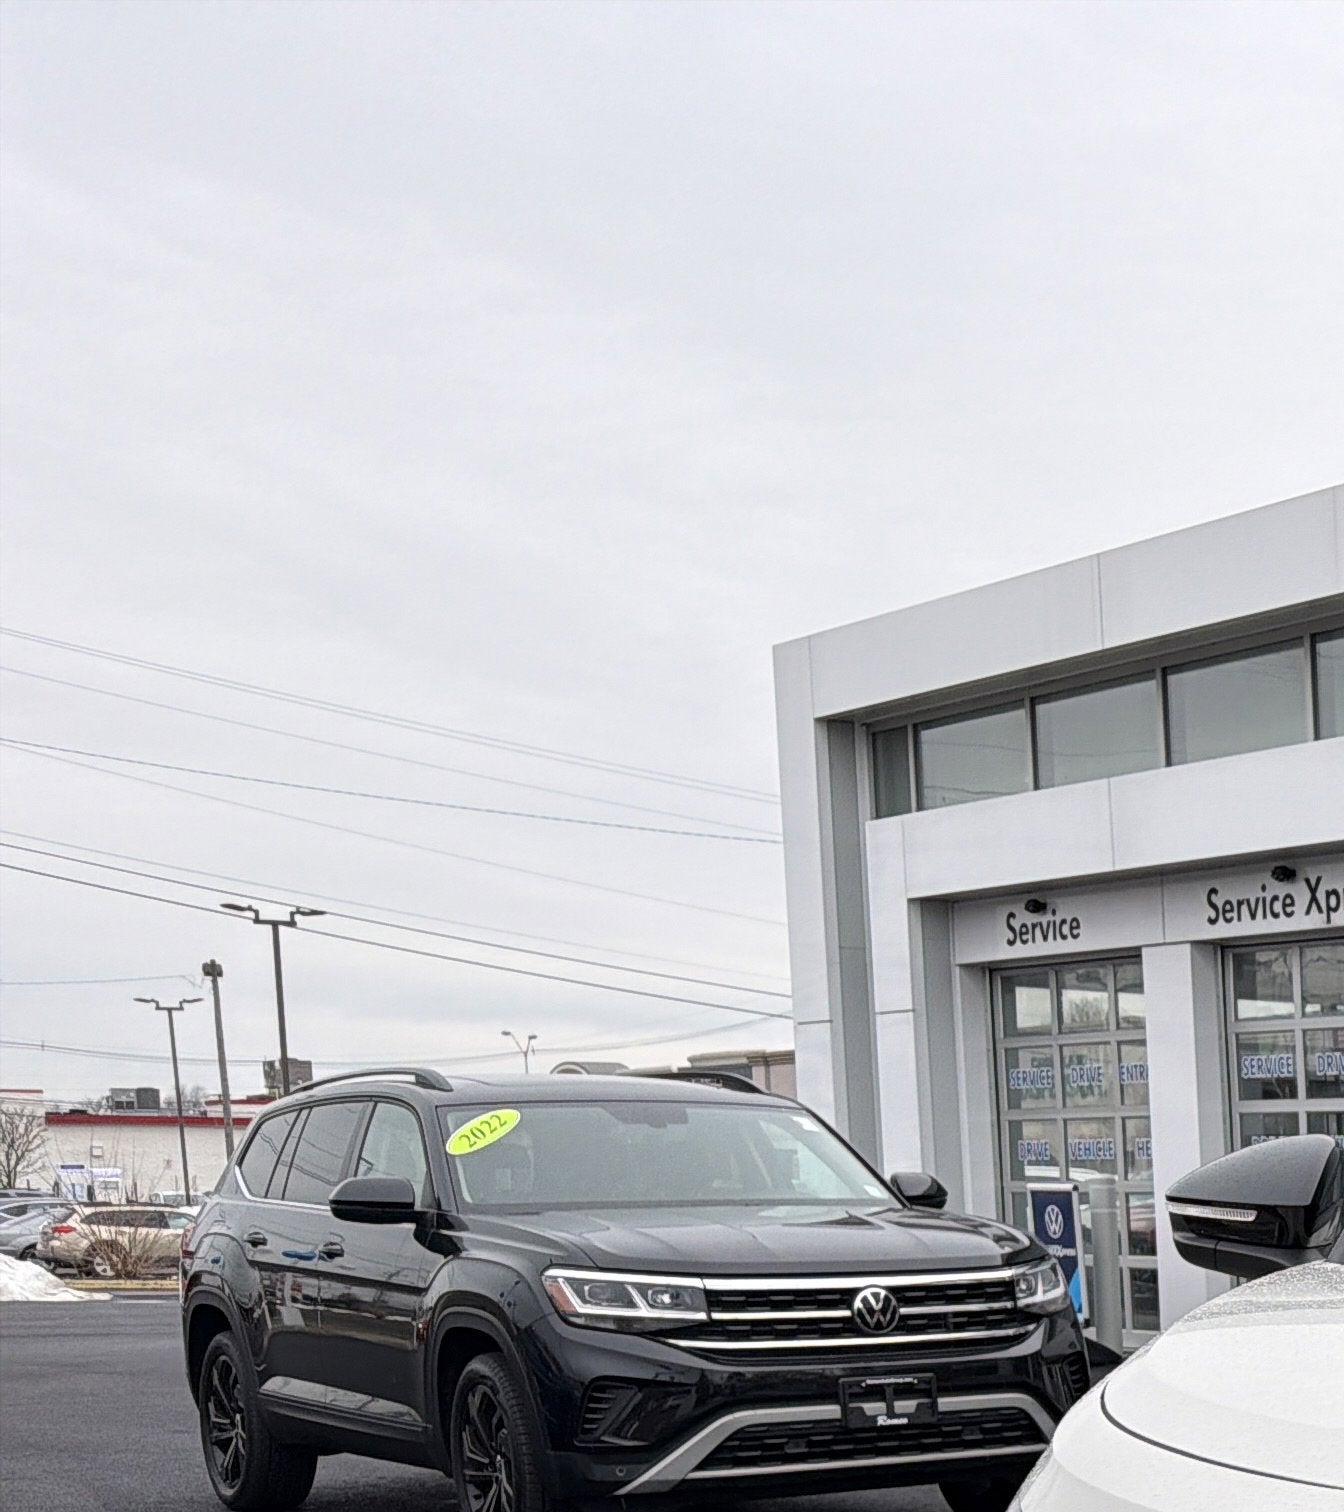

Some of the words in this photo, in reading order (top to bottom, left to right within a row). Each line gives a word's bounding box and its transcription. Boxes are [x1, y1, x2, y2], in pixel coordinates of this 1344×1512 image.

[1206, 884, 1295, 925] Service
[1006, 908, 1081, 946] Service
[1010, 1068, 1052, 1088] SERVICE
[1070, 1065, 1104, 1086] DRIVE
[1120, 1062, 1149, 1084] ENTR
[1242, 1054, 1293, 1078] SERVICE
[459, 1114, 507, 1148] 2022
[1018, 1139, 1049, 1160] DRIVE
[1069, 1138, 1115, 1160] VEHICLE
